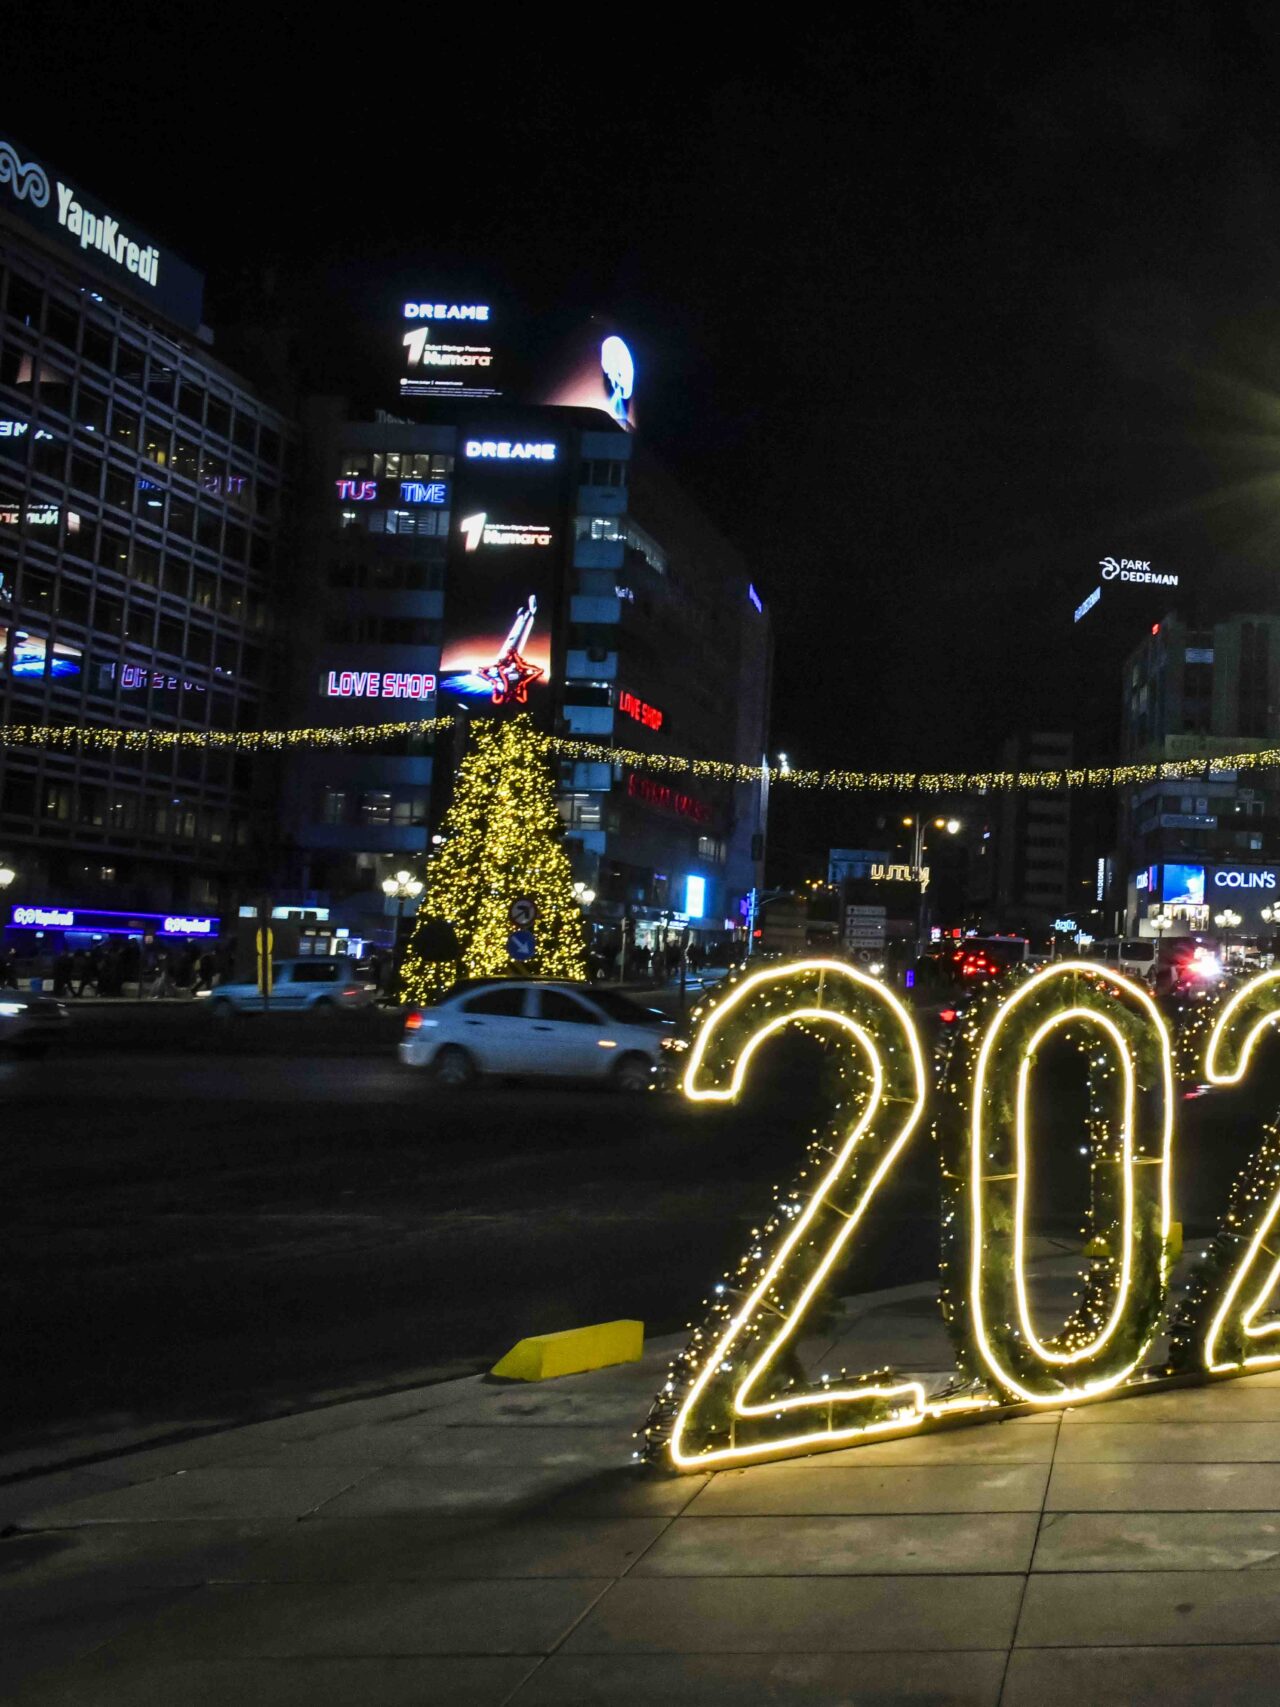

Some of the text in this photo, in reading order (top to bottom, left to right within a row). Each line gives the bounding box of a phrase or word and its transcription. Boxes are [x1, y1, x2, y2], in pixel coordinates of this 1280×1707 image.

[404, 303, 490, 320] DREAME
[403, 327, 428, 368] 1
[466, 441, 555, 460] DREAME
[335, 480, 377, 501] TUS
[461, 513, 486, 552] 1
[1120, 559, 1151, 571] PARK
[1120, 570, 1179, 586] DEDEMAN
[327, 671, 436, 699] LOVE SHOP
[1214, 871, 1276, 889] COLIN'S
